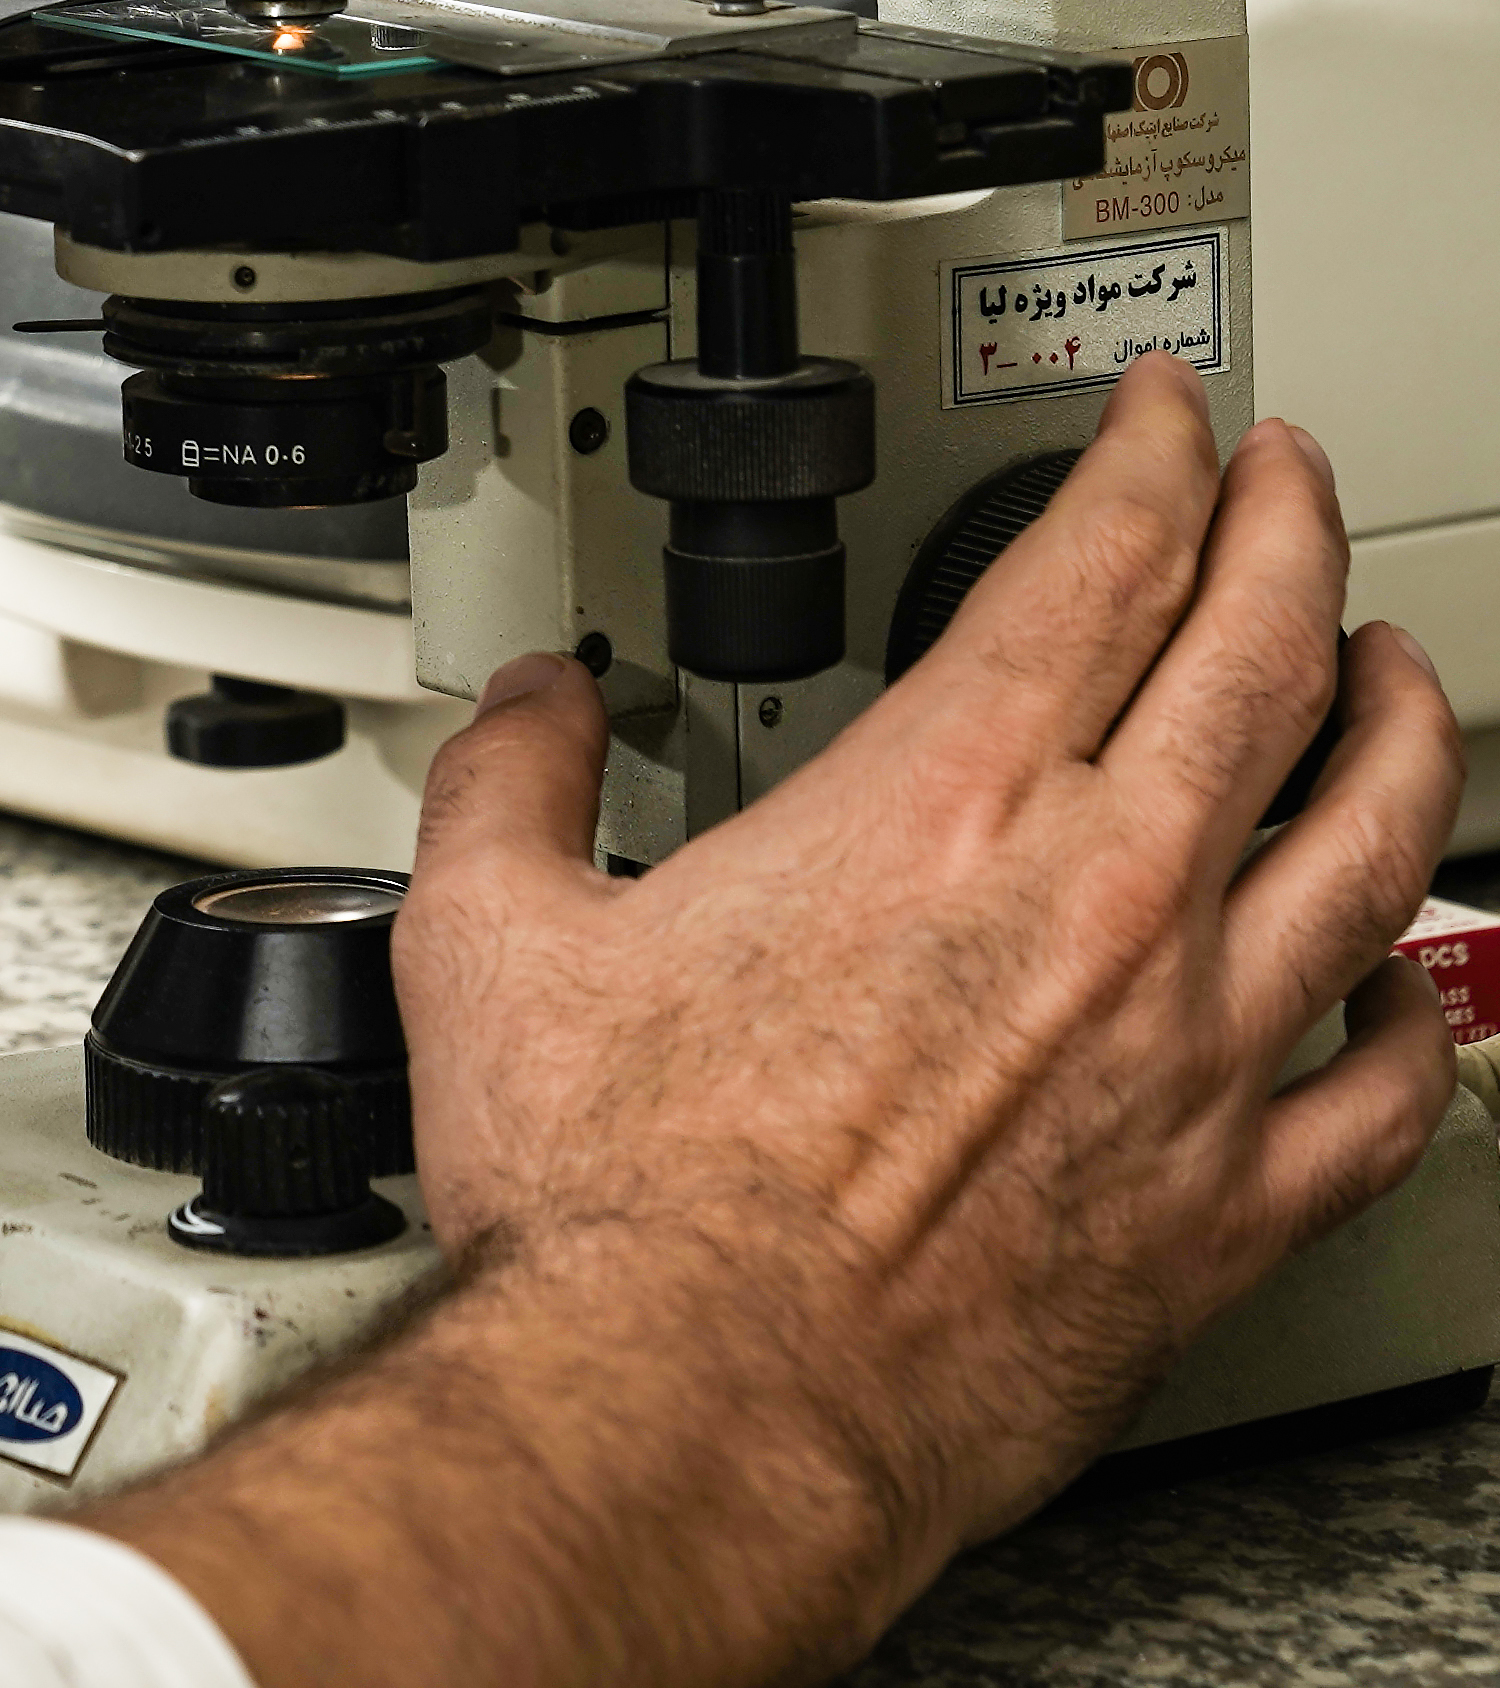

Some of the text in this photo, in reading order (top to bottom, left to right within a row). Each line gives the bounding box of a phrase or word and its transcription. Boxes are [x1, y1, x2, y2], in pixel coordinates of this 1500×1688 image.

[1107, 121, 1133, 143] اصفها
[1190, 112, 1219, 132] شرکت
[1160, 145, 1246, 182] میکروسکوپ
[1096, 190, 1180, 223] BM-300
[979, 260, 1197, 324] شرکت مواد ویژه لیا
[1114, 336, 1157, 364] اموال
[1163, 329, 1211, 355] شماره
